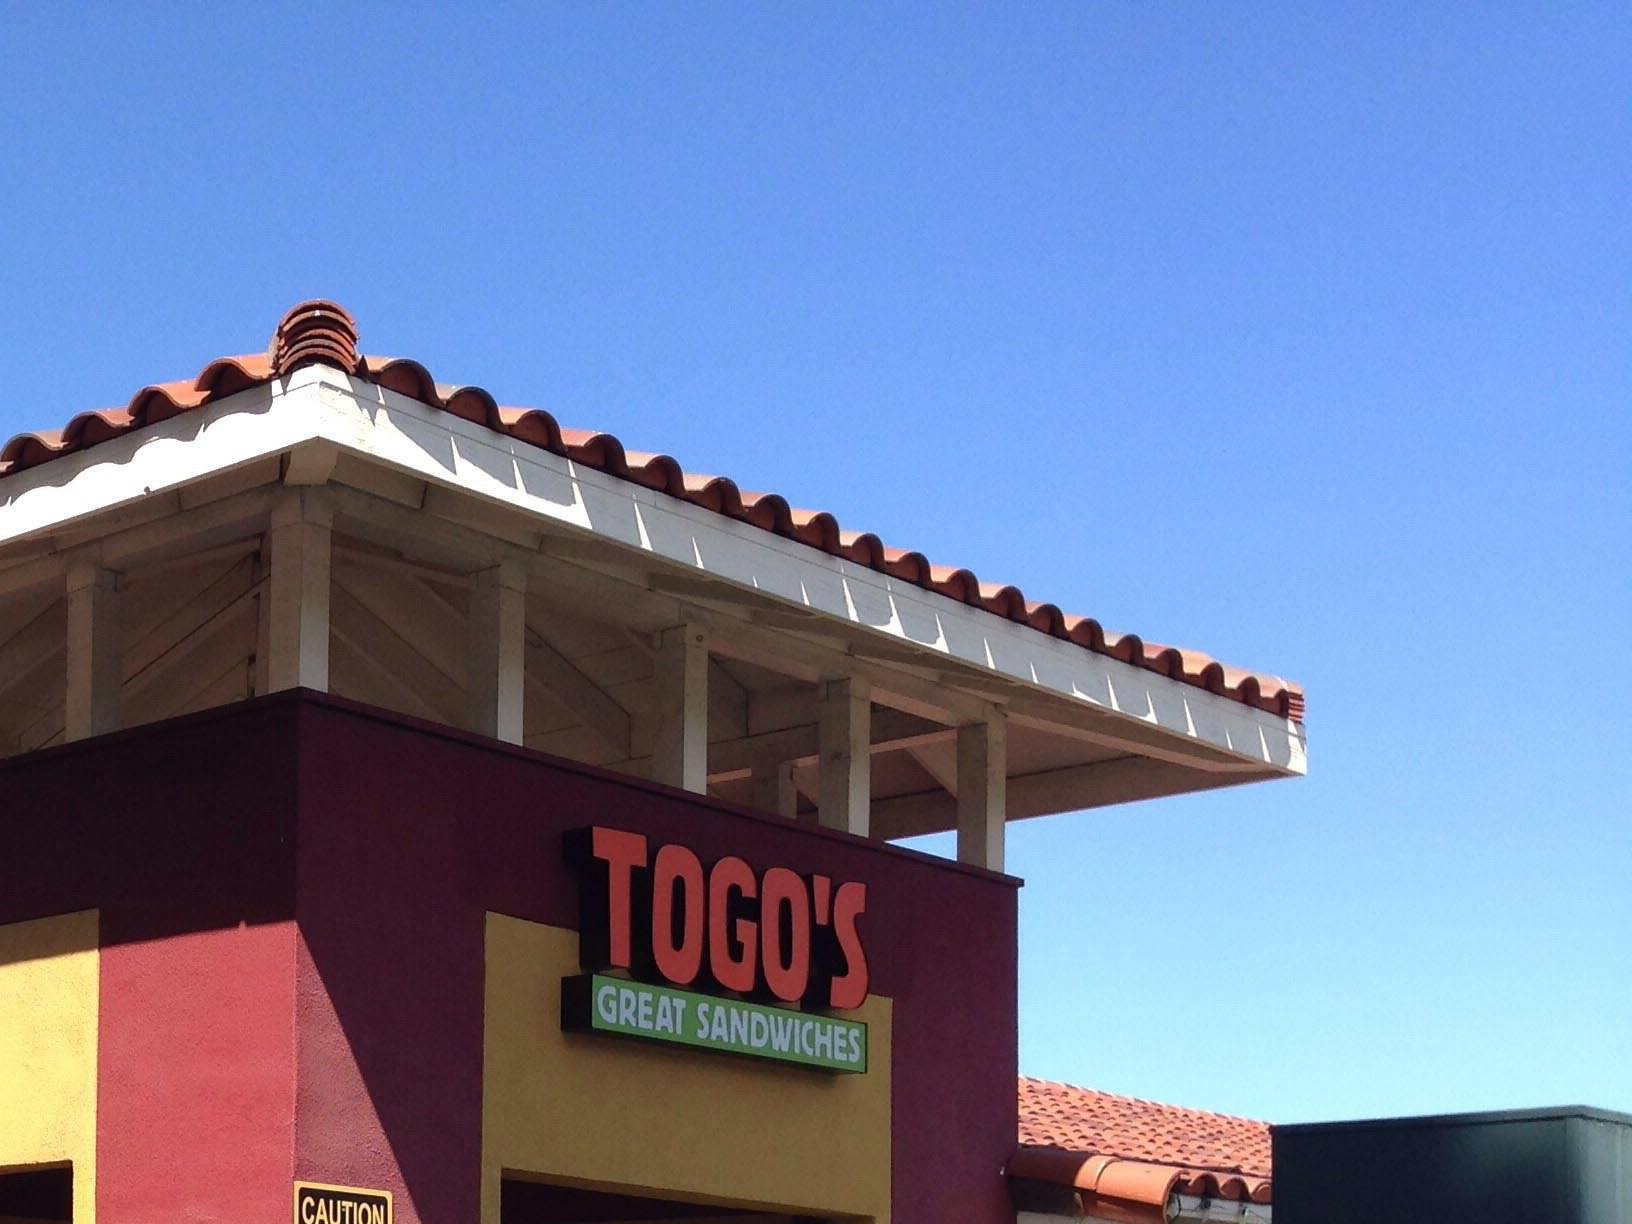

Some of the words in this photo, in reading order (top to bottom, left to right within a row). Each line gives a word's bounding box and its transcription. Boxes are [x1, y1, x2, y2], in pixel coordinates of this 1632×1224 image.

[592, 826, 869, 1010] TOGO'S
[596, 985, 686, 1035] GREAT
[697, 1002, 861, 1063] SANDWICHES
